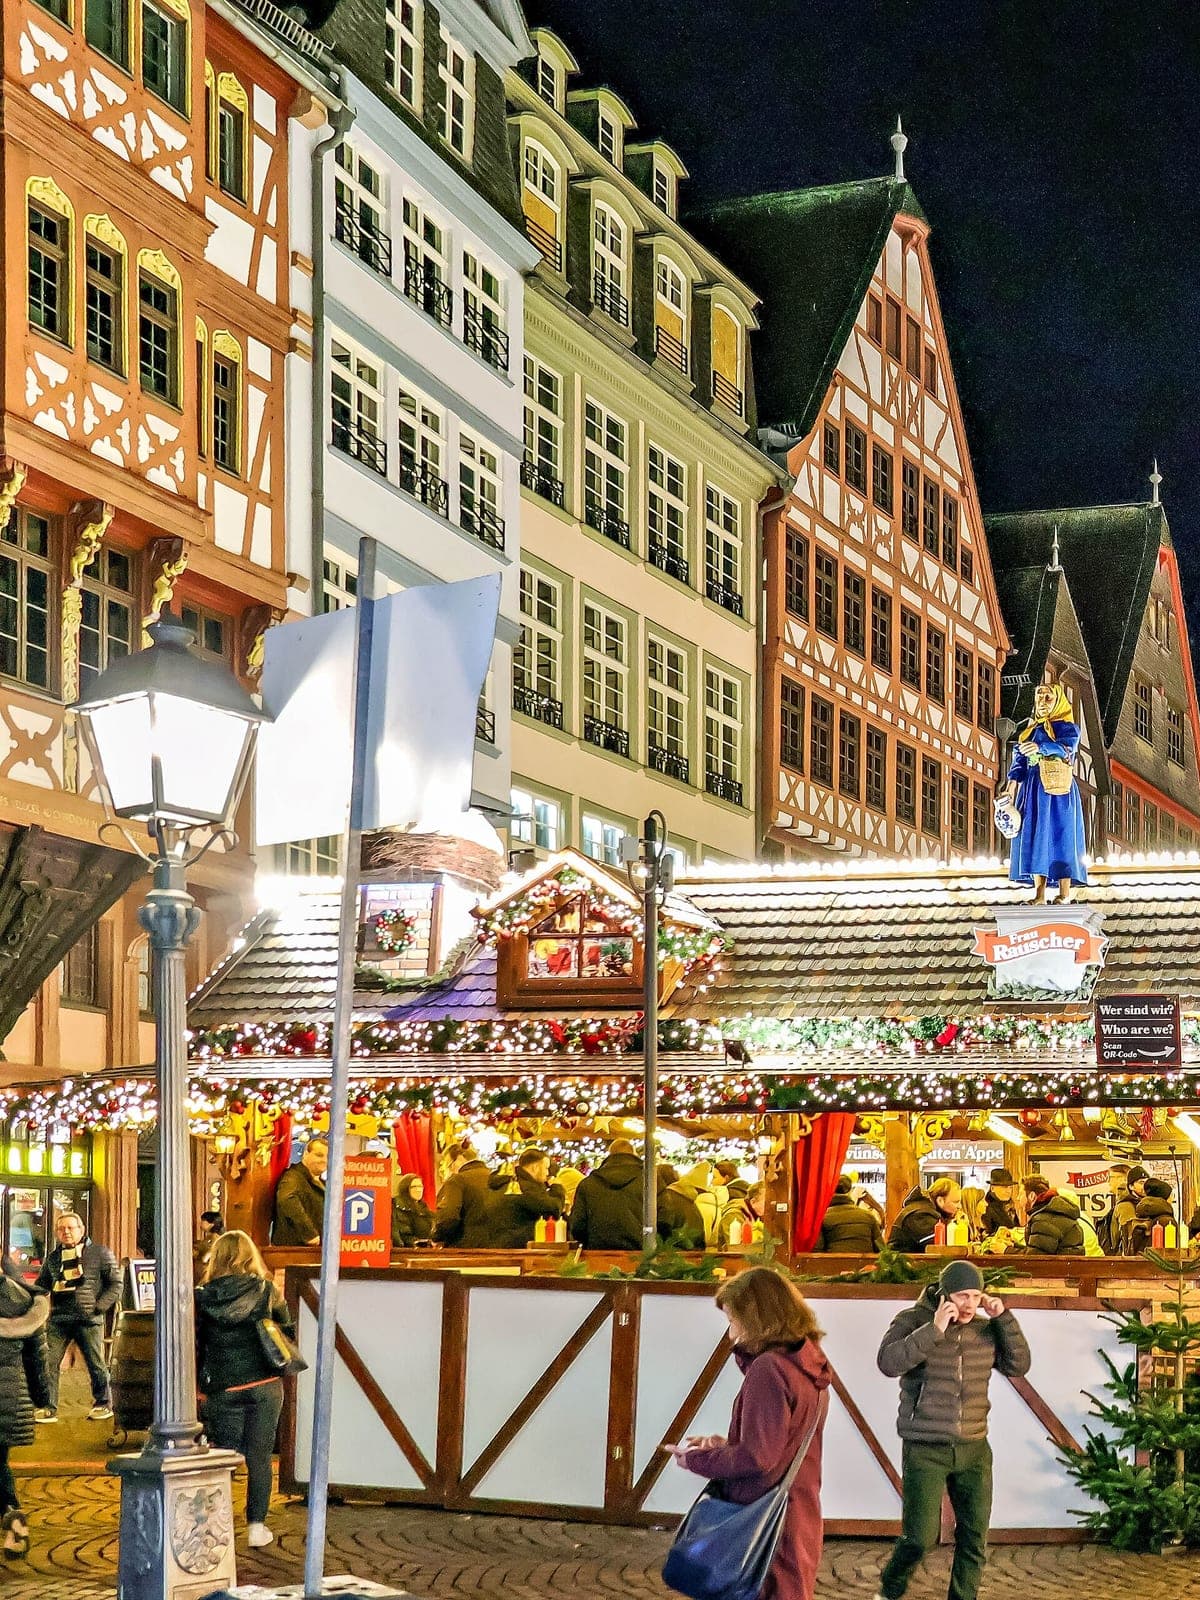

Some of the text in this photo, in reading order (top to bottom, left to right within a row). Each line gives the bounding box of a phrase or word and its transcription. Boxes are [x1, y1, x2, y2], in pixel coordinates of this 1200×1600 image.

[1008, 930, 1039, 945] Frau
[993, 931, 1085, 961] Rauscher
[1099, 1004, 1174, 1015] Wer sind wir?
[1101, 1024, 1174, 1035] Who are we?
[1102, 1042, 1122, 1050] Scan
[1103, 1051, 1138, 1059] QR-Code
[1077, 1173, 1110, 1187] HAUSM
[350, 1200, 370, 1232] P
[341, 1239, 385, 1252] NGANG
